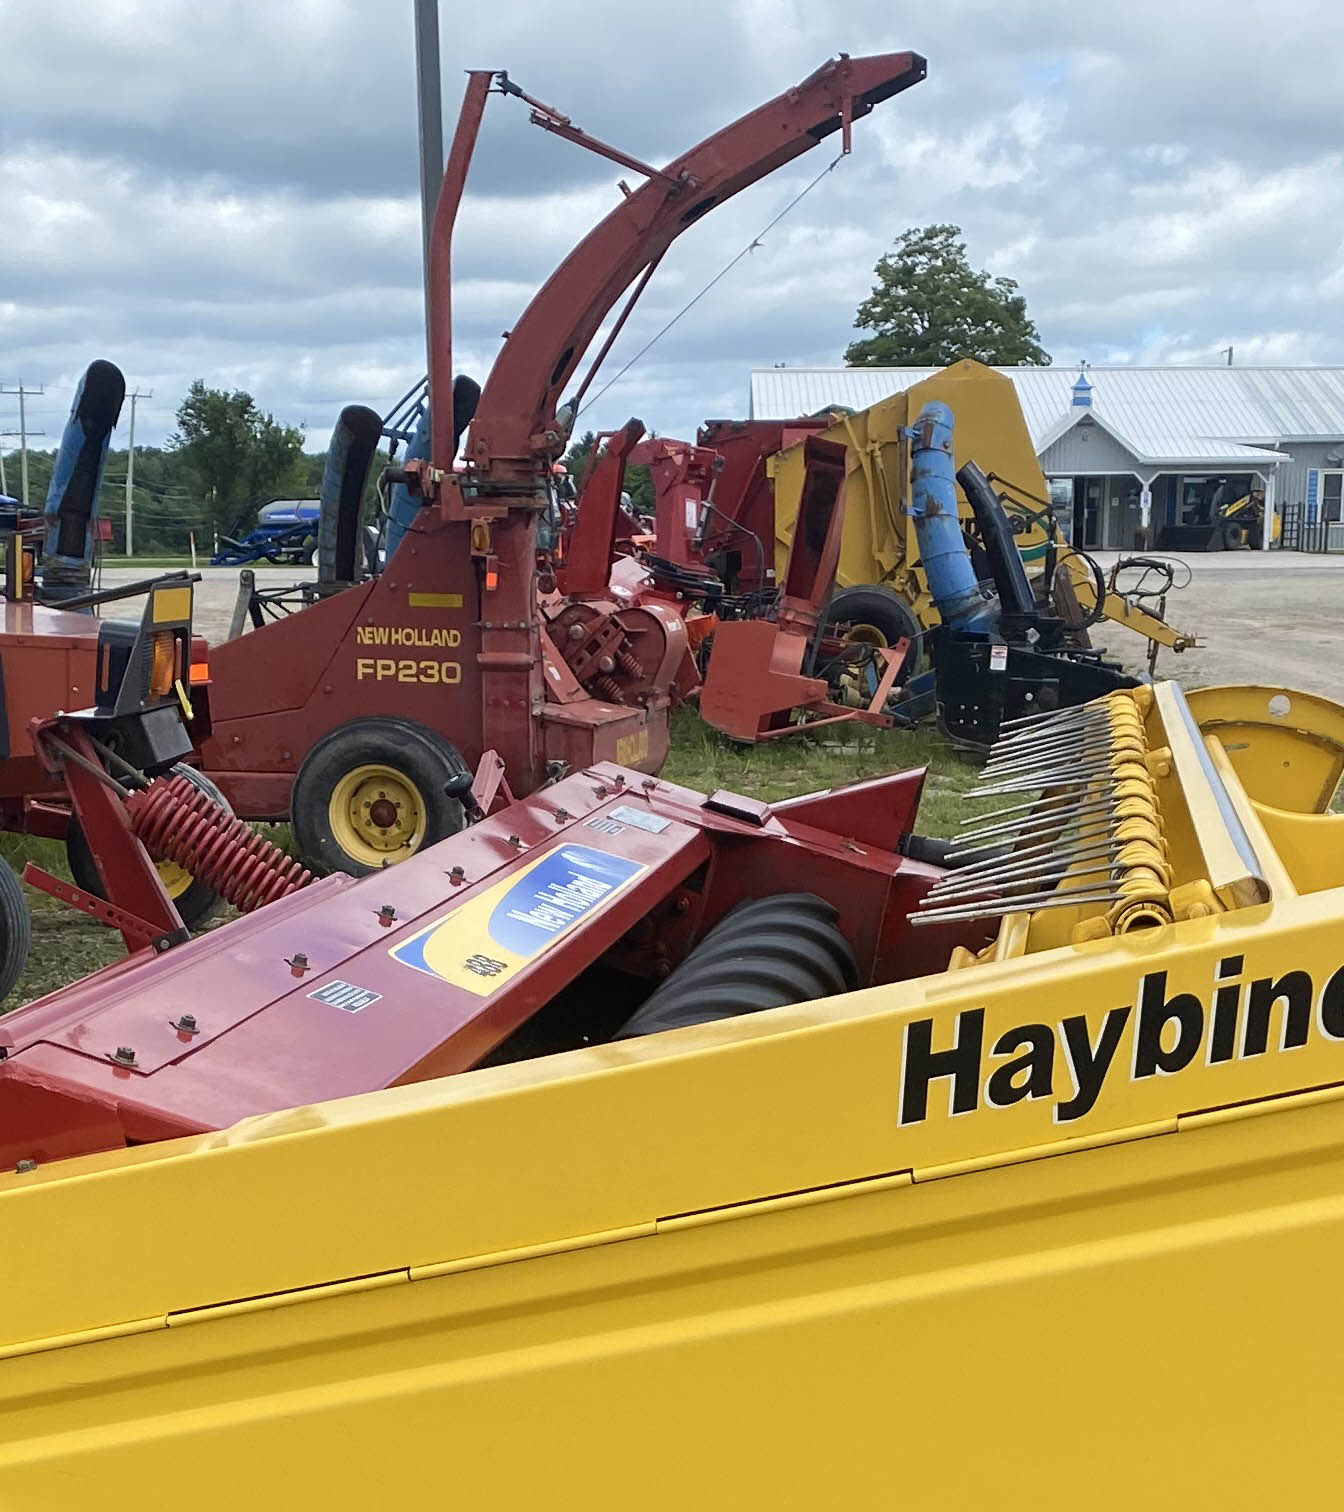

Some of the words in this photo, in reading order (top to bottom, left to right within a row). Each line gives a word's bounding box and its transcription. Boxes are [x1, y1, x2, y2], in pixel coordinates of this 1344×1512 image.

[357, 626, 390, 645] NEW
[391, 627, 461, 648] HOLLAND
[357, 658, 462, 684] FP230
[534, 871, 613, 913] Holland
[506, 902, 575, 932] New
